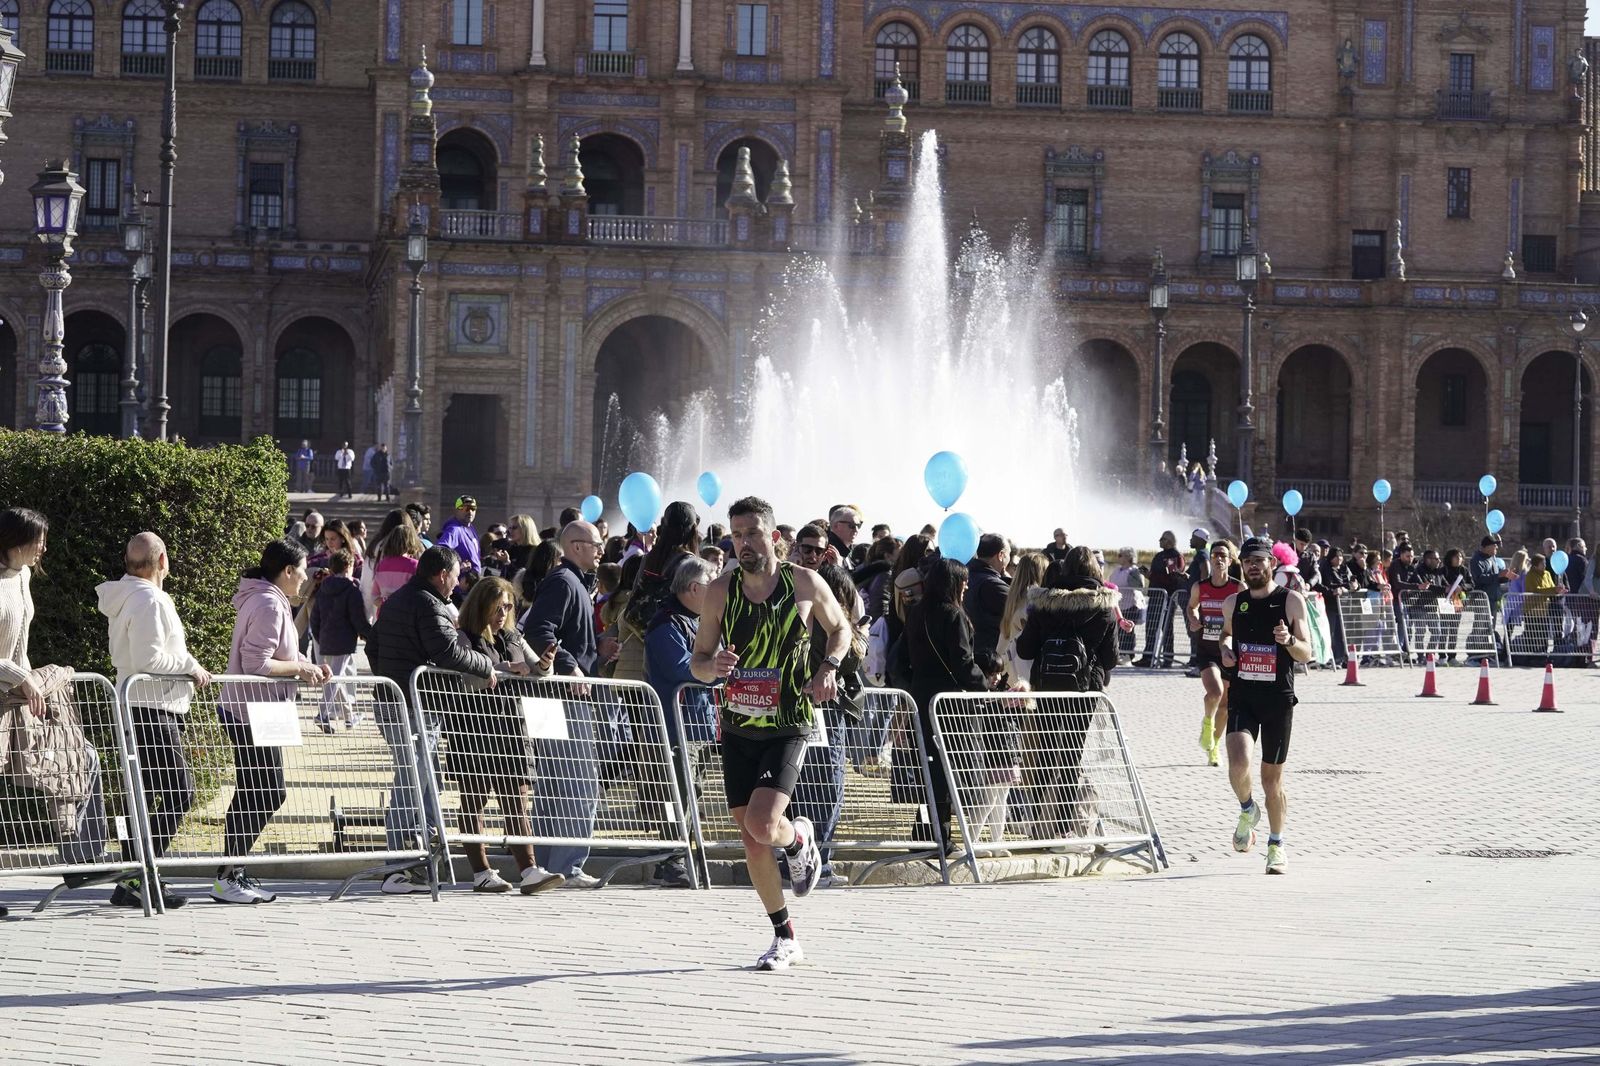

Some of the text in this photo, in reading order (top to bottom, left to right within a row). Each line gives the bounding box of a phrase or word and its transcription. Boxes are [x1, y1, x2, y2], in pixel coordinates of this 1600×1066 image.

[1249, 645, 1272, 653] ZURICH
[1241, 662, 1272, 672] MATHIEU
[731, 692, 773, 706] ARRIBAS
